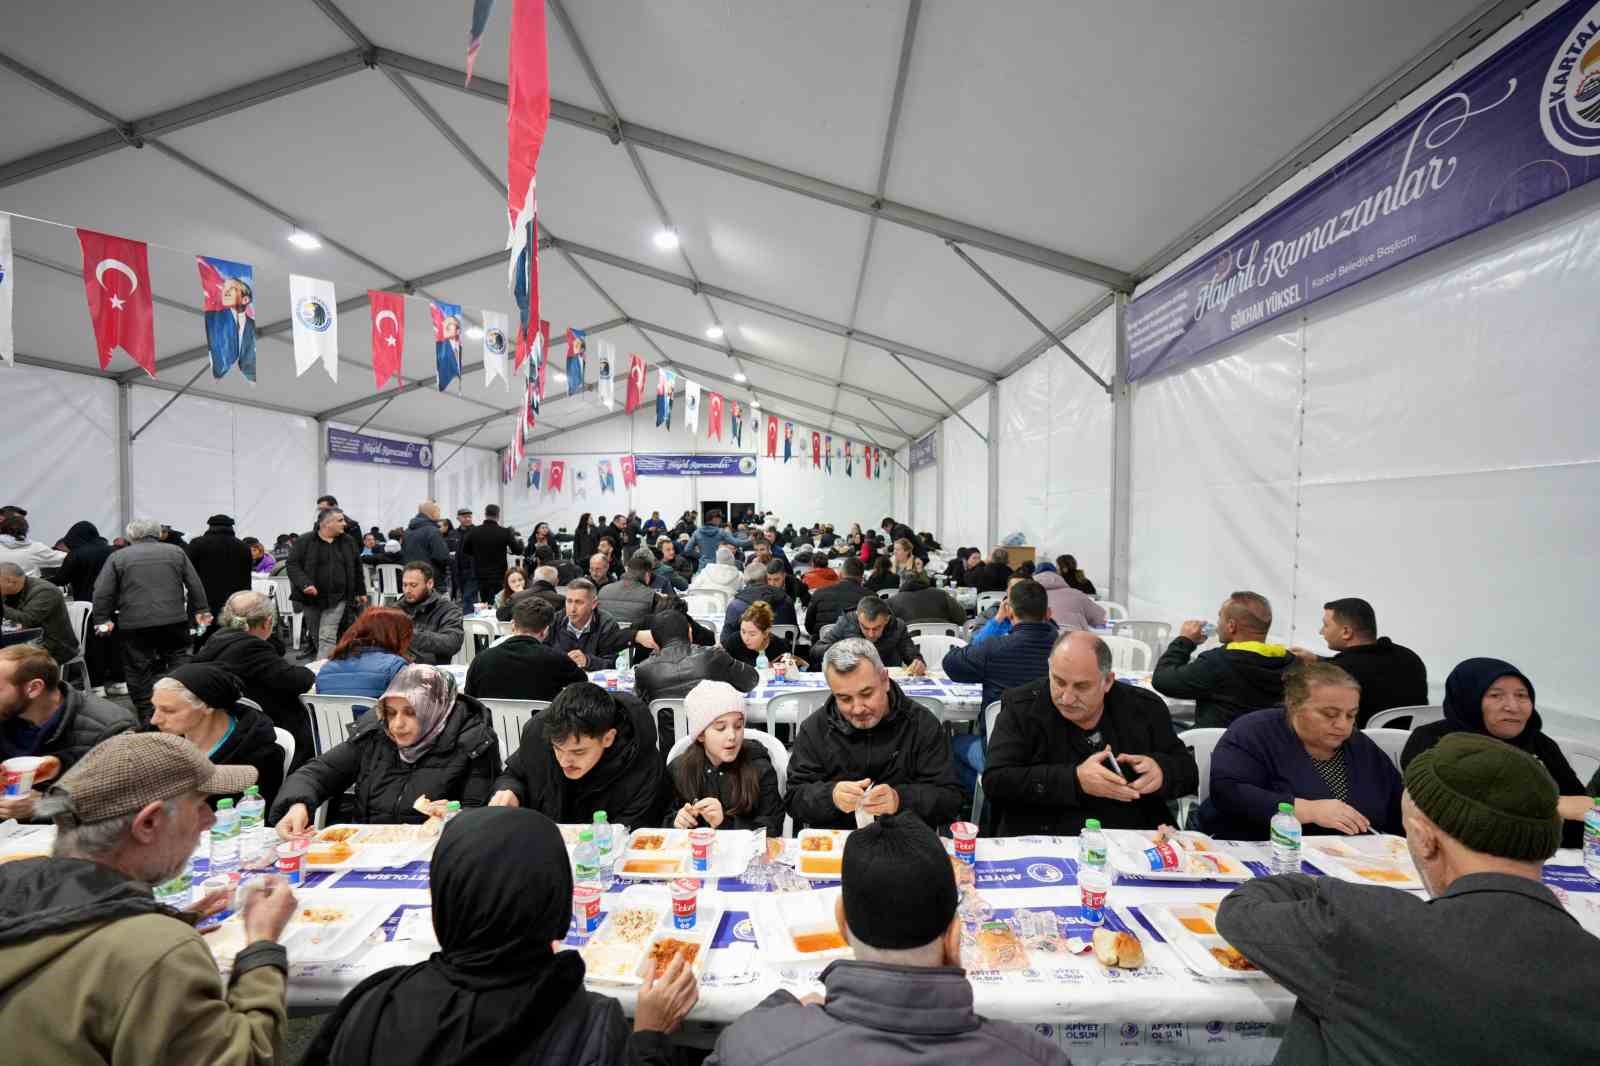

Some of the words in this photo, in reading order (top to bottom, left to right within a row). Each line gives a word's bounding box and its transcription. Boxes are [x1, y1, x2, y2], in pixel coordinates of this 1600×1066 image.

[1549, 20, 1600, 104] KARTAL
[1194, 240, 1259, 320] Hayırlı
[1265, 283, 1302, 316] YÜKSEL
[1065, 1031, 1098, 1039] OLSUN
